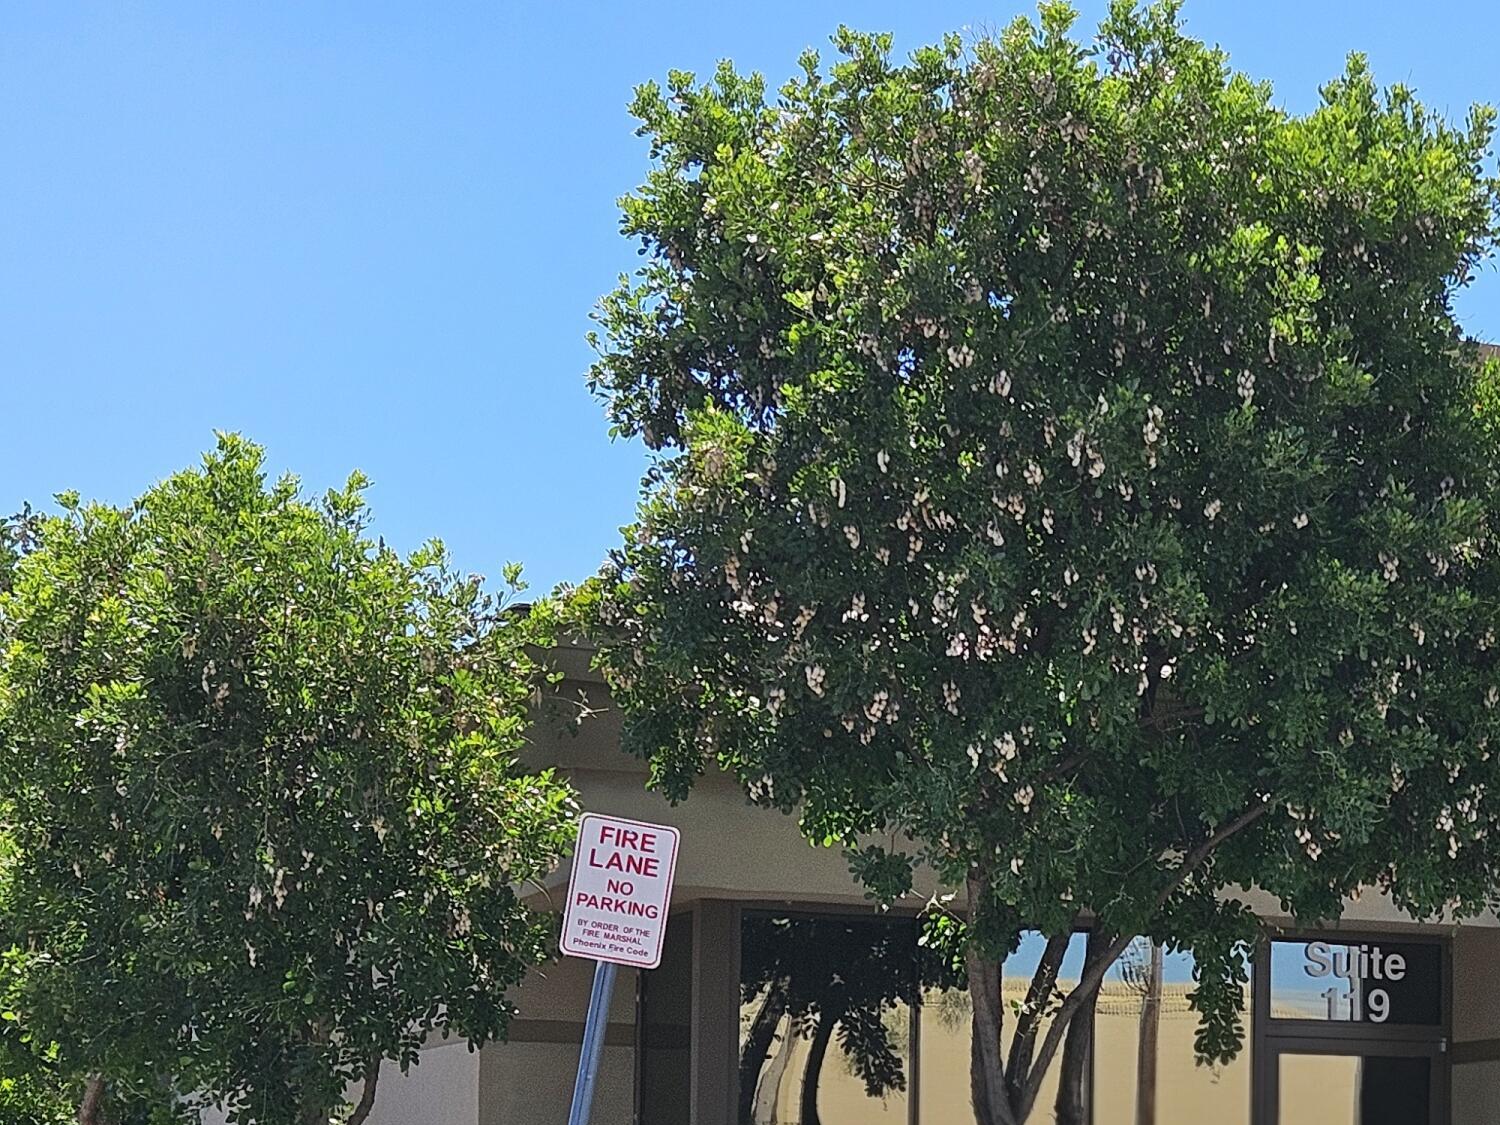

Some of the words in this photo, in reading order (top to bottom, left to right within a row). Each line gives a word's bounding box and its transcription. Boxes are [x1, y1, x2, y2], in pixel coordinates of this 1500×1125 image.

[600, 826, 656, 853] FIRE
[589, 849, 660, 877] LANE
[607, 879, 634, 895] NO
[576, 893, 658, 919] PARKING
[577, 918, 589, 926] BY
[591, 921, 619, 932] ORDER
[623, 926, 634, 934] OF
[635, 928, 651, 938] THE
[582, 928, 600, 938] FIRE
[603, 932, 642, 945] MARSHAL
[573, 937, 606, 950] Phoenix
[608, 943, 624, 952] Fire
[626, 946, 649, 957] Code
[1304, 941, 1406, 980] Suite
[1321, 987, 1390, 1023] 119
